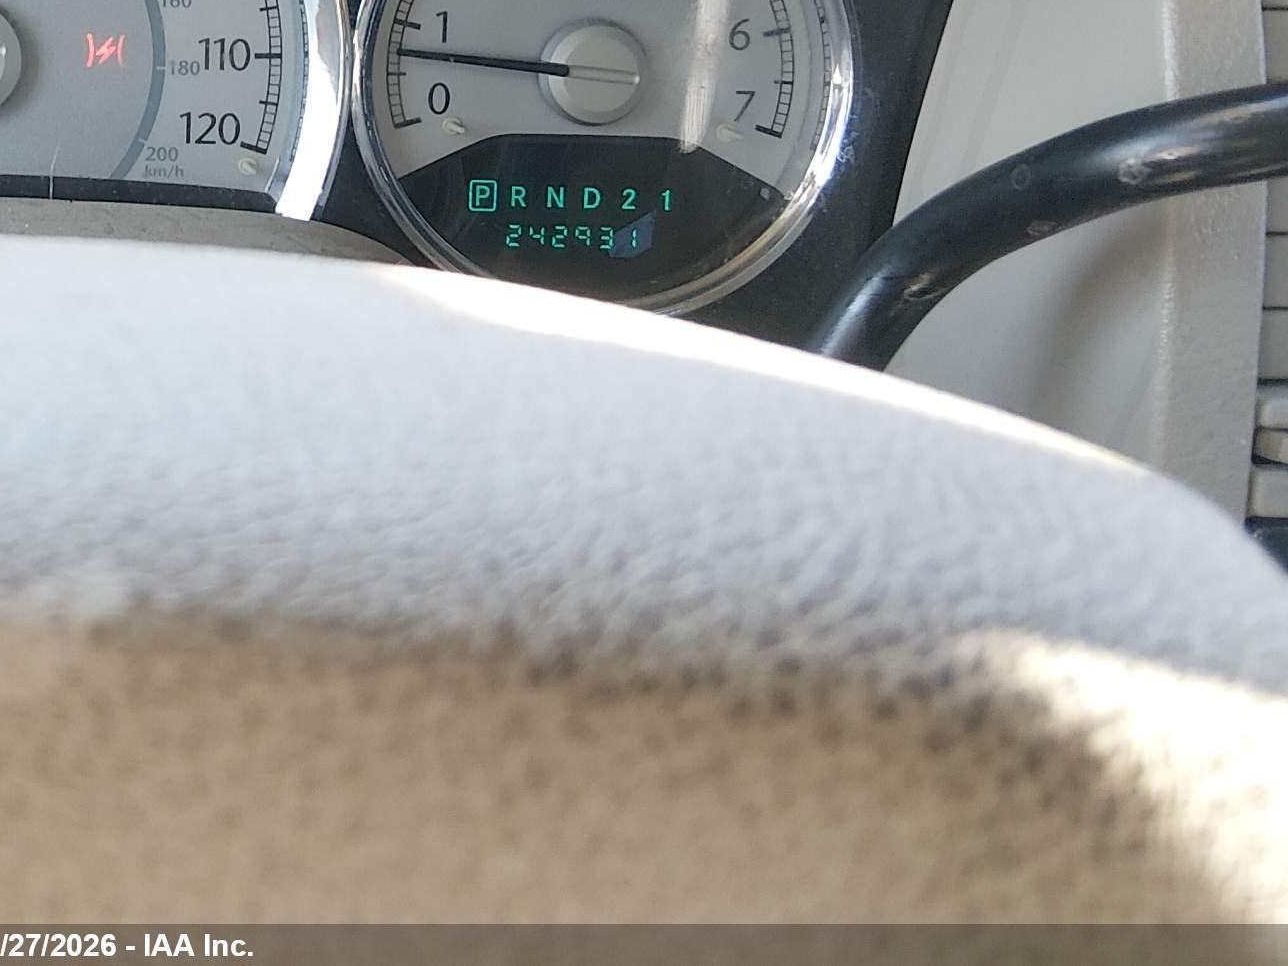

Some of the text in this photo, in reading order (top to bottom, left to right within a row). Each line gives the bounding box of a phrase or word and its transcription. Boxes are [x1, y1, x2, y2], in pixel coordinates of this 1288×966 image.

[436, 10, 449, 43] 1
[729, 19, 750, 51] 6
[168, 60, 200, 76] 180
[199, 38, 251, 71] 110
[428, 83, 450, 115] 0
[734, 91, 756, 122] 7
[180, 112, 240, 146] 120
[145, 146, 179, 163] 200
[144, 164, 184, 179] km/h
[475, 184, 672, 211] P R N D 2 1
[506, 224, 638, 250] 242931
